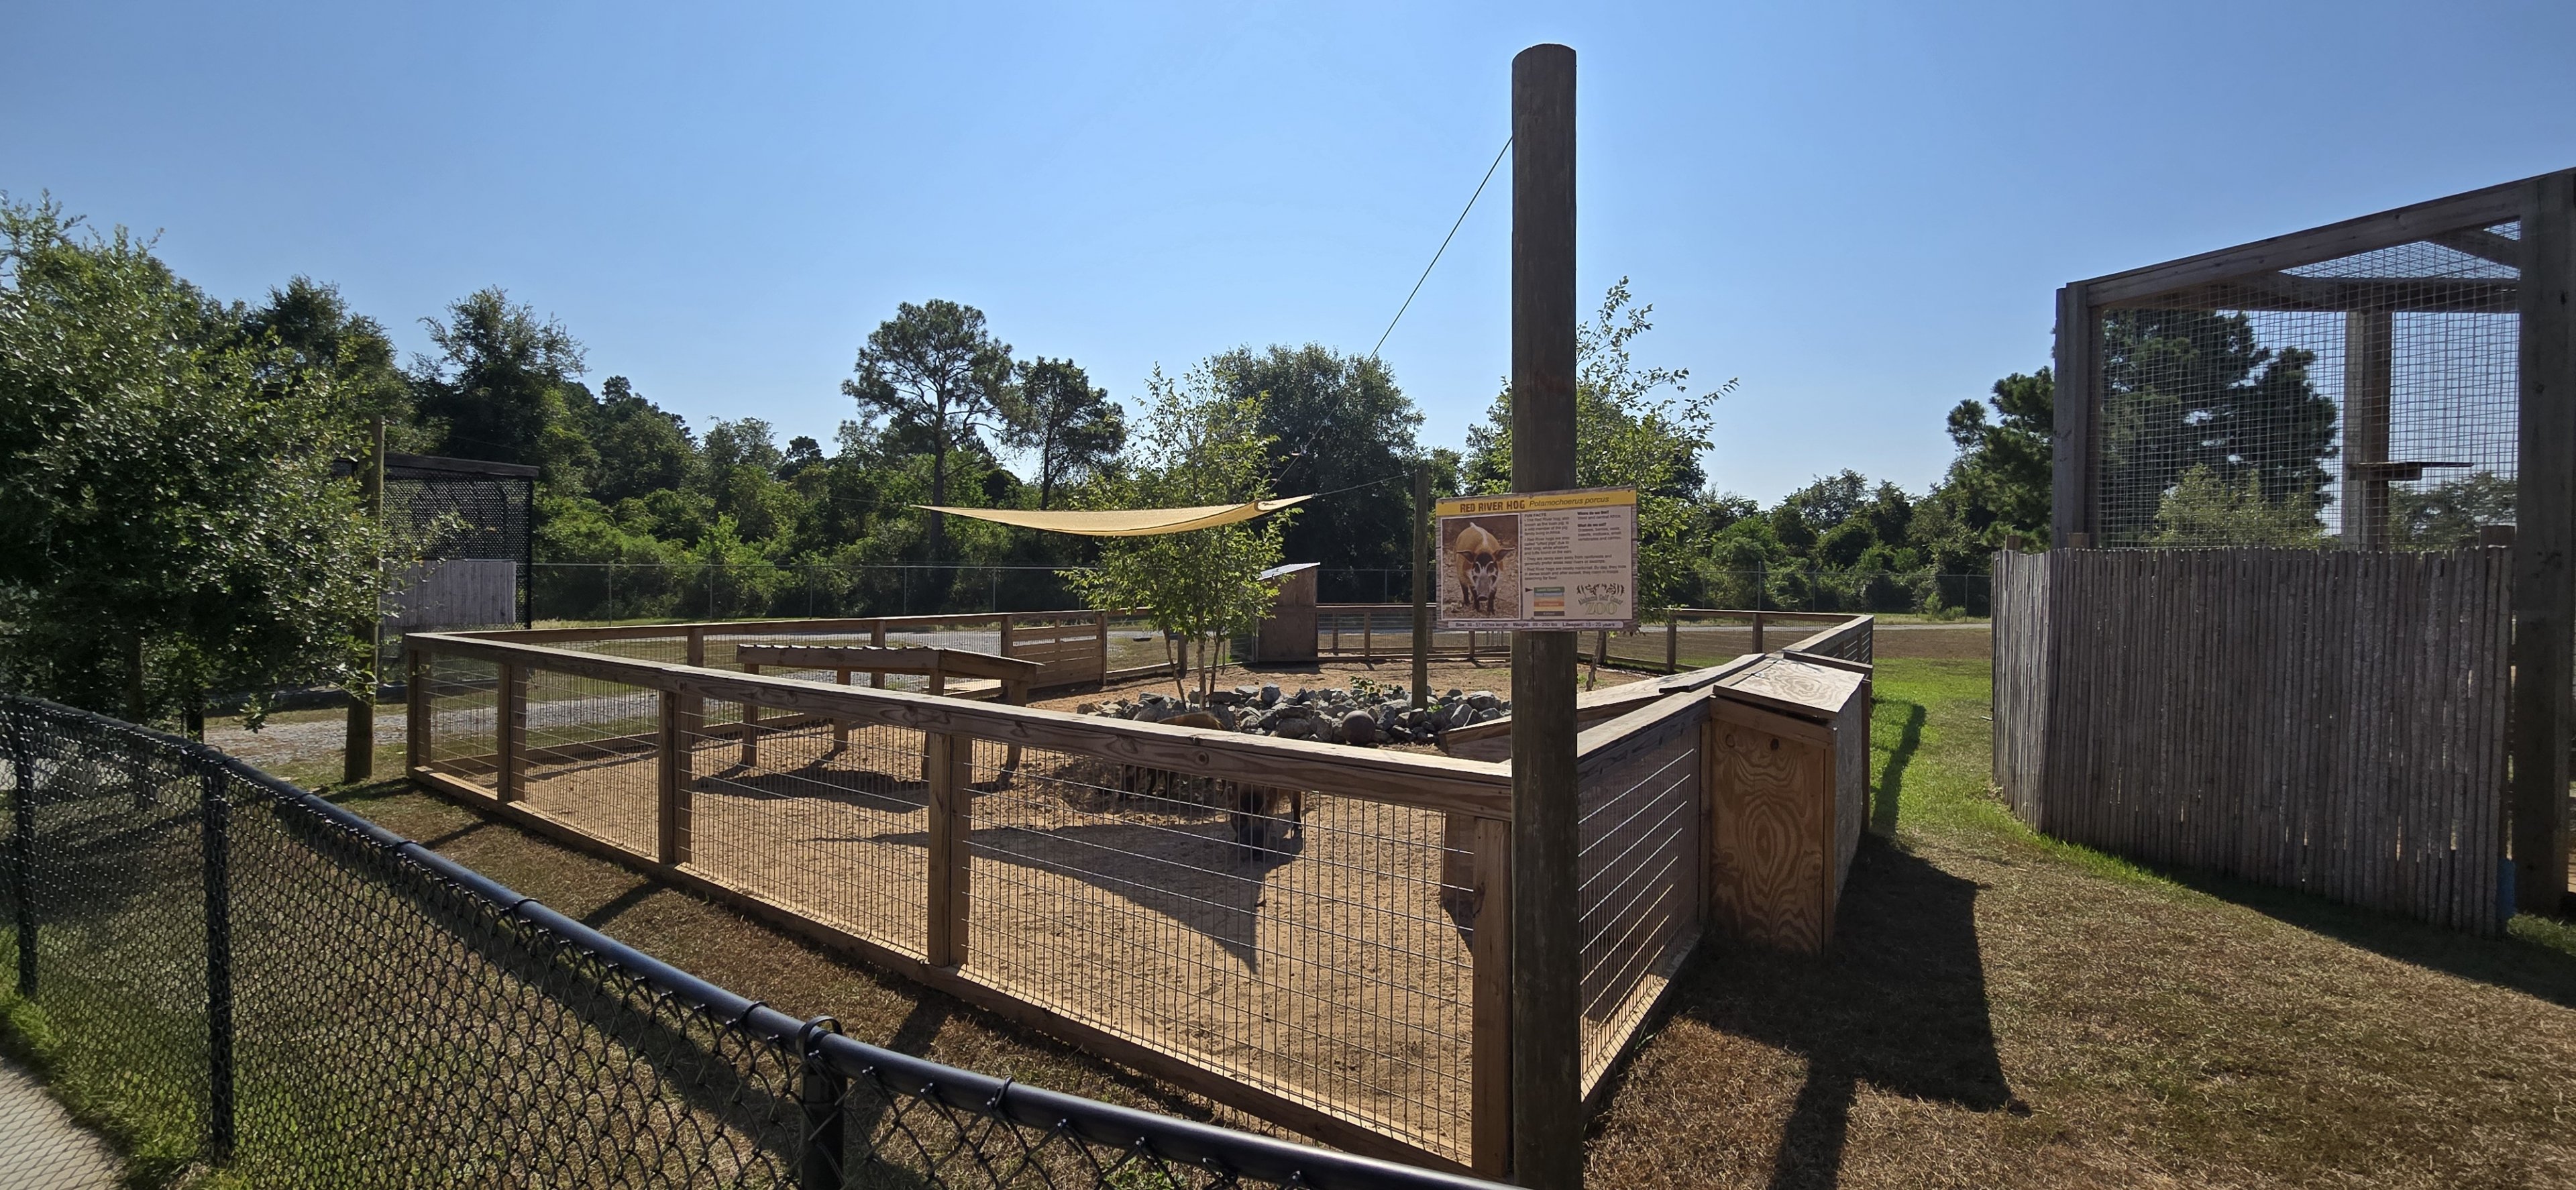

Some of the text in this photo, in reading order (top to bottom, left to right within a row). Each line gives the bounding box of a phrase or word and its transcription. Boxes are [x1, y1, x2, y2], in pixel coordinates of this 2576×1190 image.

[1460, 503, 1475, 512] RED
[1479, 502, 1503, 512] RIVER
[1507, 500, 1525, 510] HOG
[1585, 497, 1609, 505] porcus
[1578, 596, 1597, 606] Alabama
[1610, 595, 1623, 605] Coast
[1585, 602, 1617, 614] ZOO
